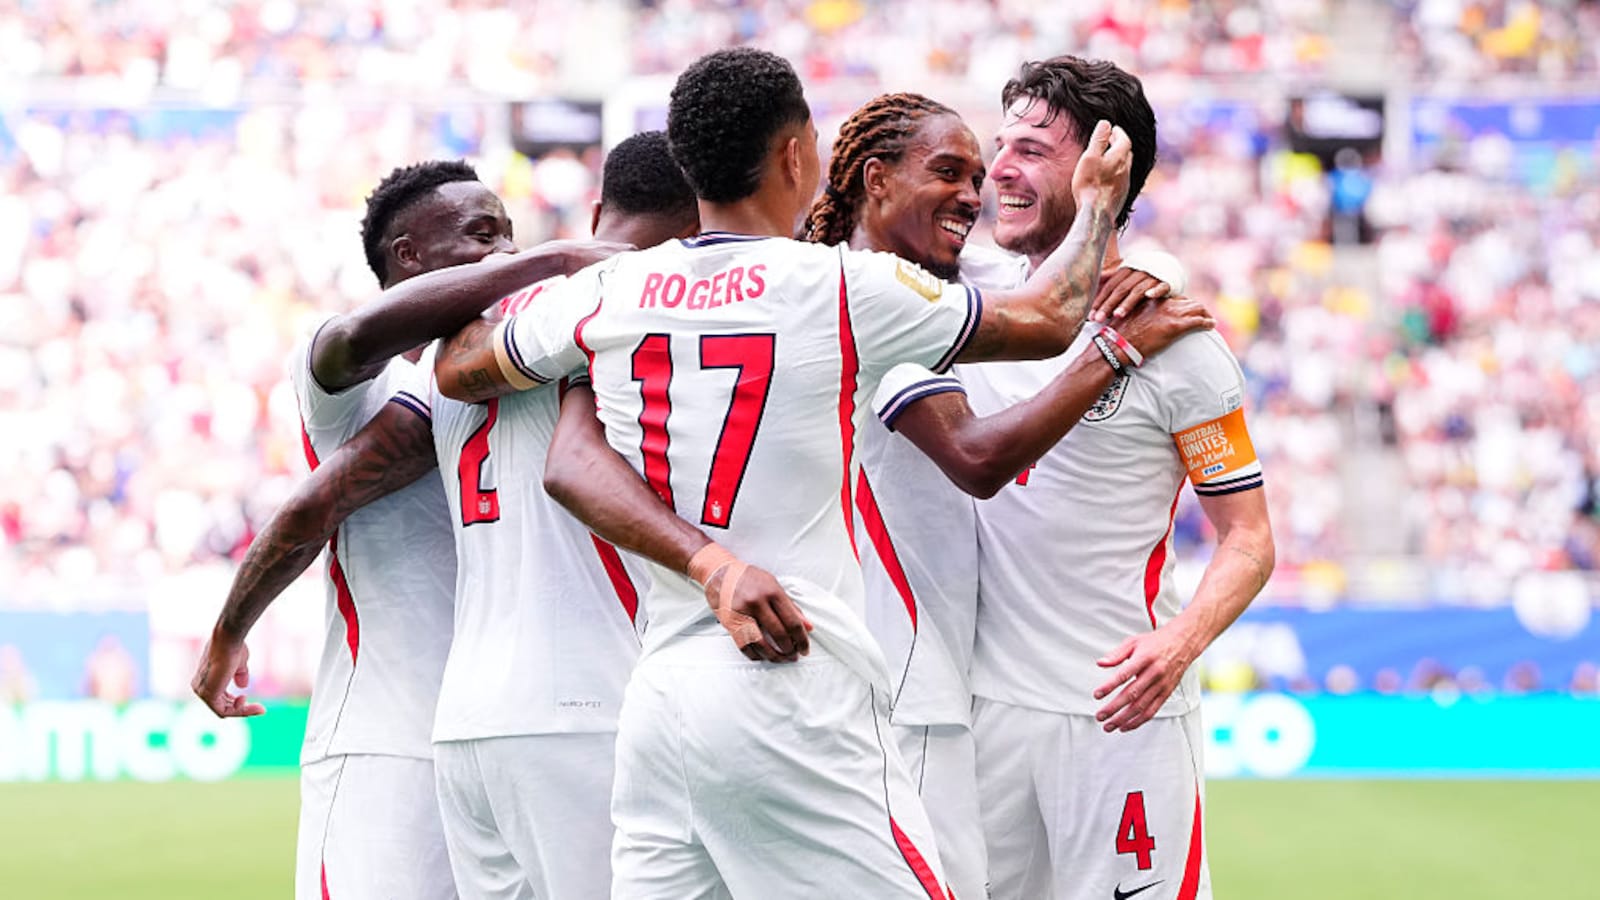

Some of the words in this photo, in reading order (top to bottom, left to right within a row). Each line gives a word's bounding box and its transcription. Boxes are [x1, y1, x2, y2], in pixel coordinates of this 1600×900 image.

[639, 264, 767, 310] ROGERS
[631, 333, 776, 529] 17
[1179, 421, 1223, 445] FOOTBALL
[1183, 432, 1228, 458] UNITES
[1202, 443, 1236, 465] World
[1203, 464, 1224, 476] FIFA
[1116, 791, 1155, 870] 4
